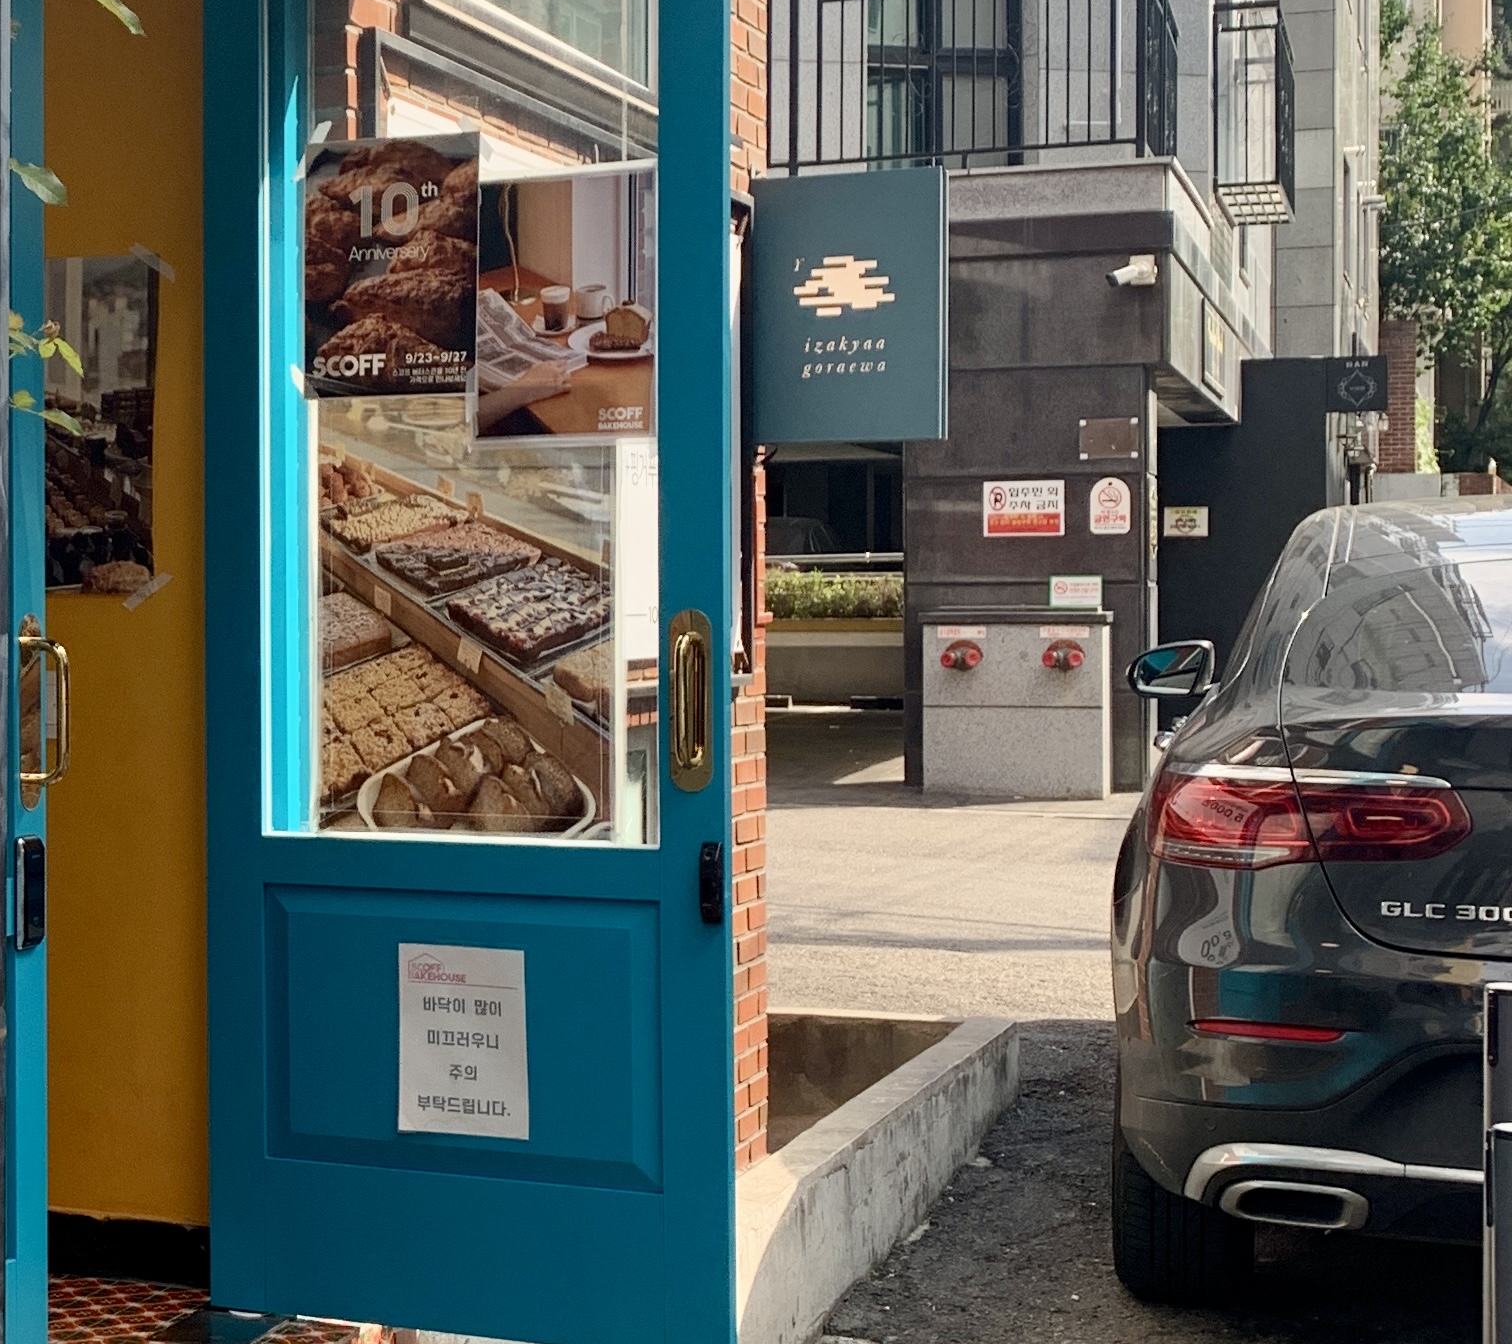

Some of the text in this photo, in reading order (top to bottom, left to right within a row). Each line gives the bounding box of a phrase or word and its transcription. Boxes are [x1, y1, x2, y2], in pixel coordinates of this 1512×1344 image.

[348, 244, 430, 263] Anniversary
[313, 353, 387, 377] SCOFF
[801, 360, 887, 379] goraewa
[598, 406, 643, 421] SCOFF
[1380, 901, 1447, 919] GLC
[423, 996, 502, 1017] 바닥이 많이
[427, 1029, 499, 1050] 미끄러우니
[449, 1063, 478, 1081] 주의
[417, 1094, 511, 1117] 부탁드립니다.
